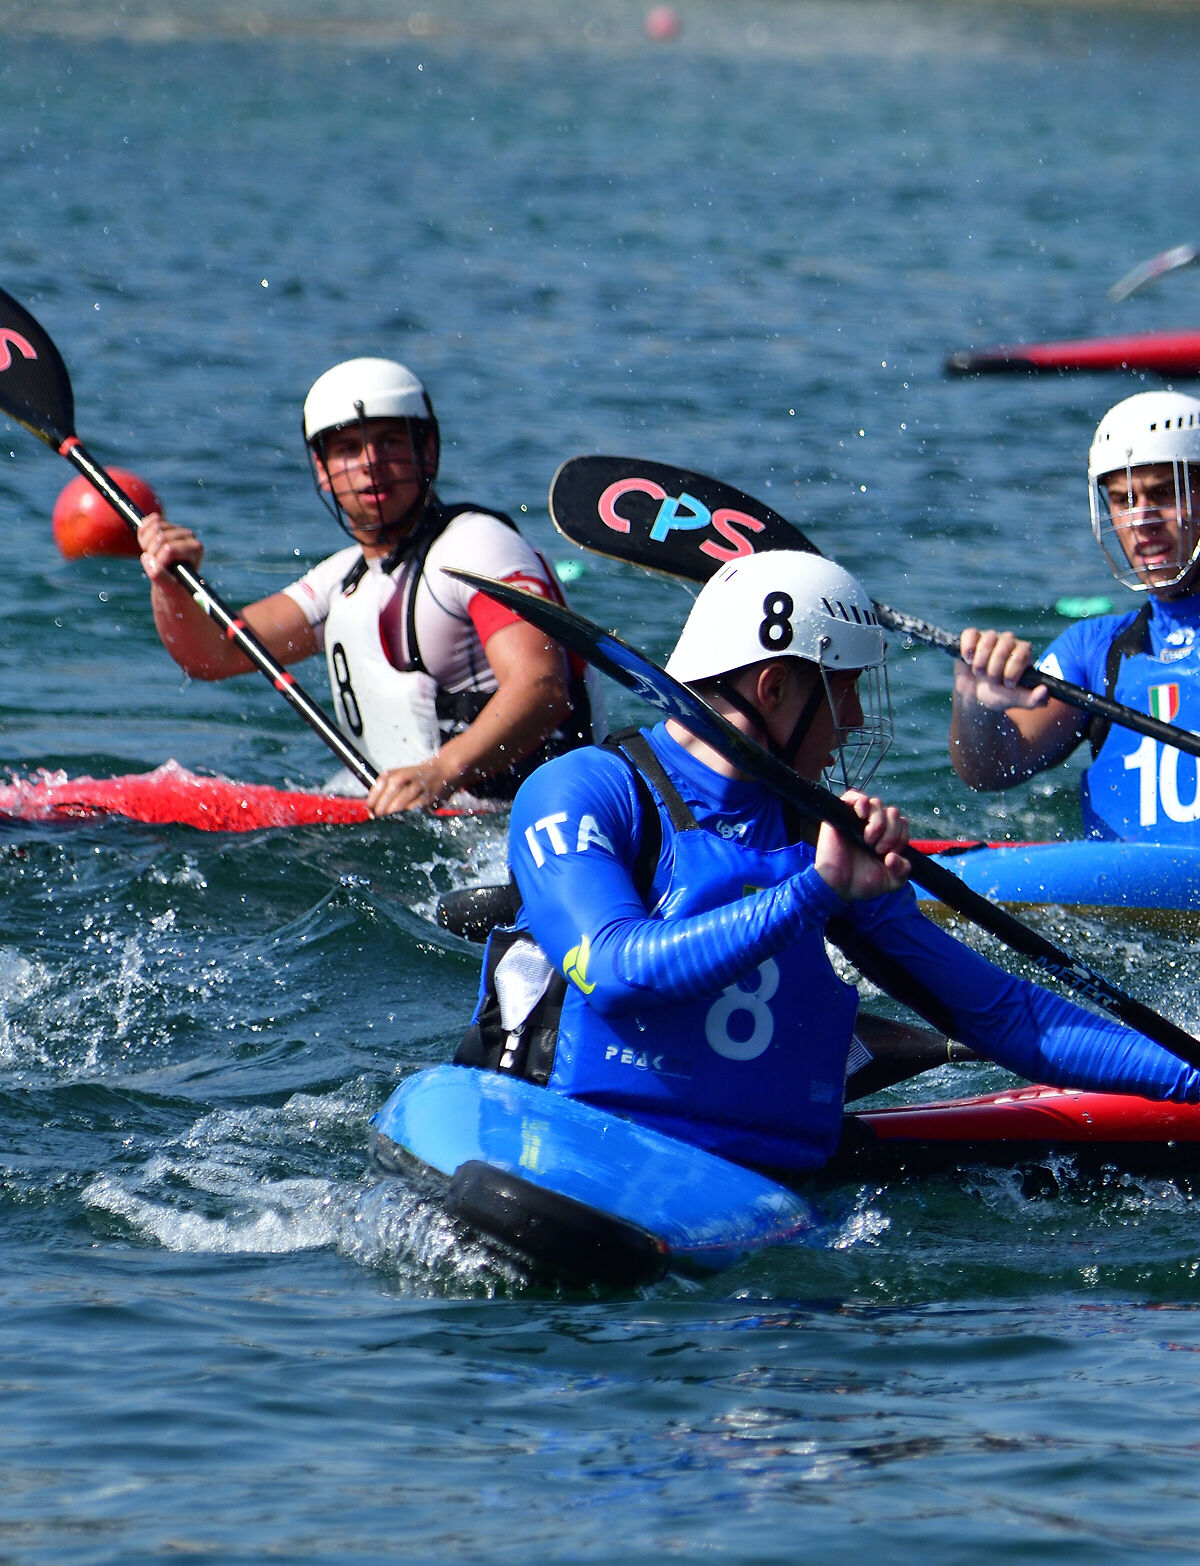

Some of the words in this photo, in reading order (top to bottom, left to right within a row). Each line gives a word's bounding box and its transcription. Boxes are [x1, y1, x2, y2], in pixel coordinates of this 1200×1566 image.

[598, 477, 766, 562] CPS
[759, 591, 794, 652] 8
[333, 642, 363, 737] 8
[525, 811, 615, 868] ITA
[705, 957, 779, 1061] 8
[605, 1046, 664, 1070] PEAK
